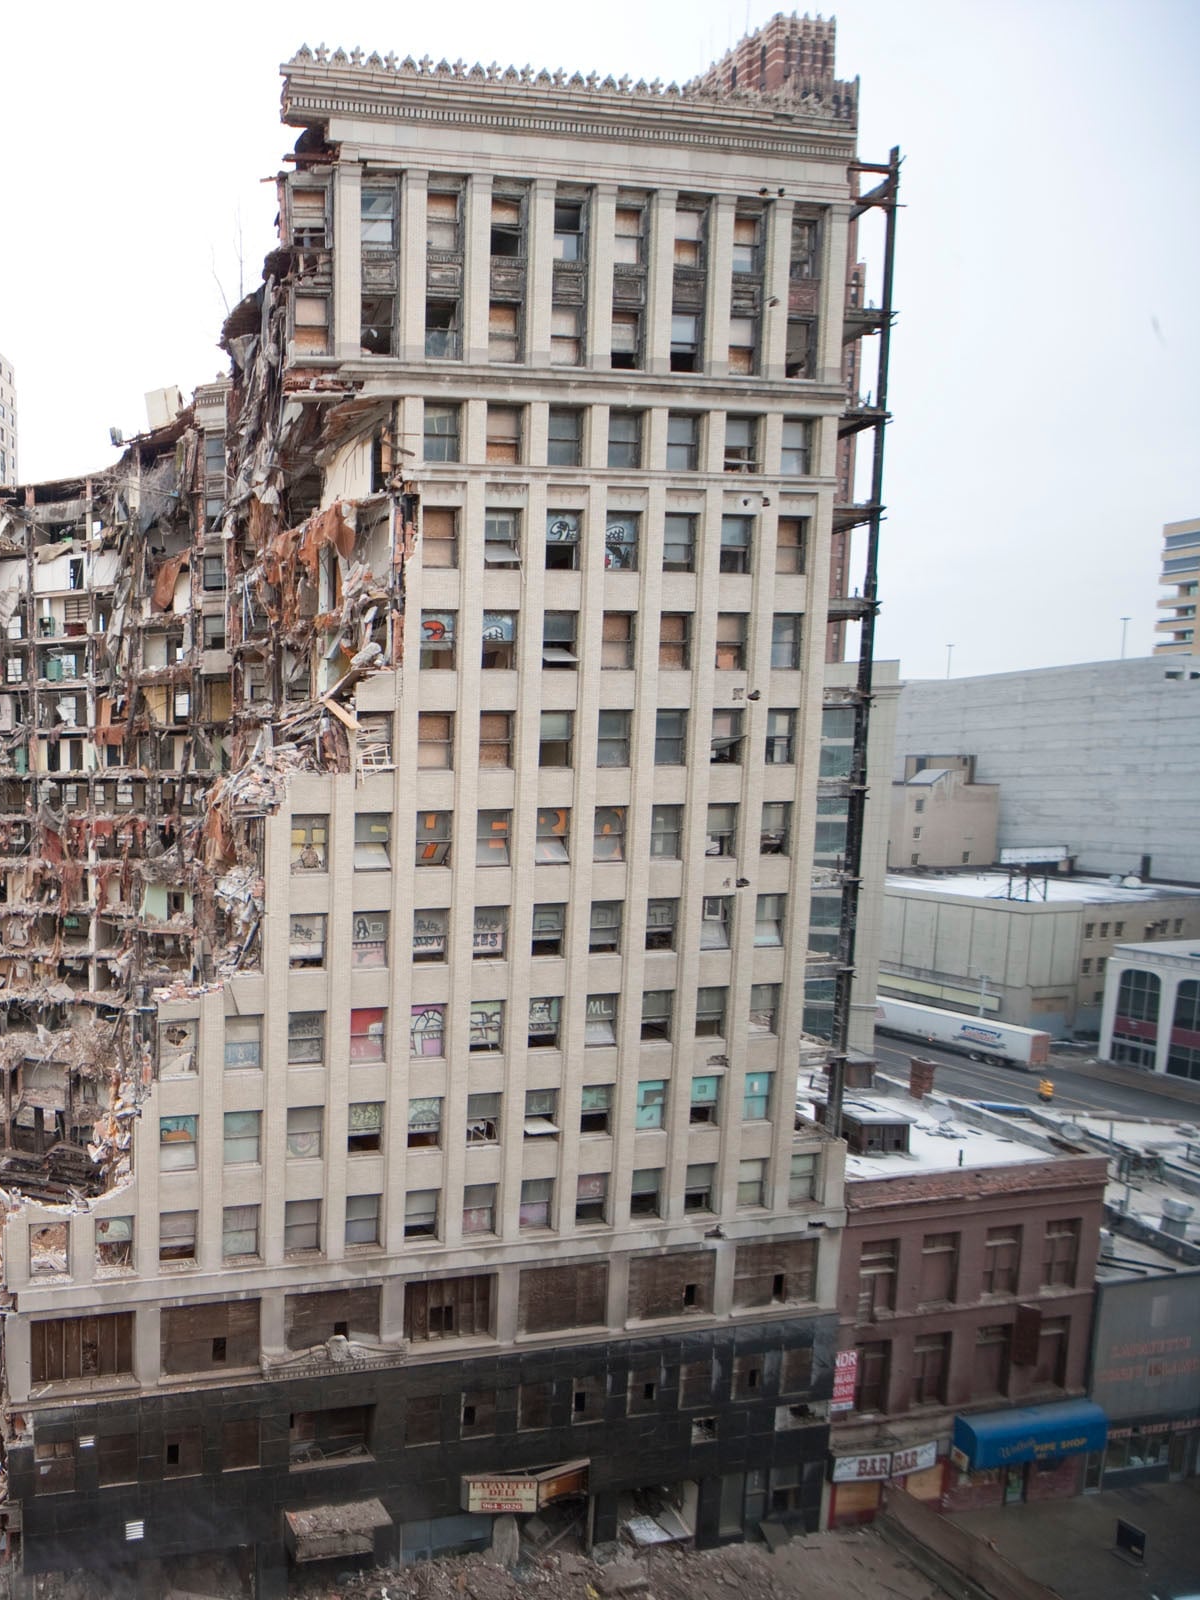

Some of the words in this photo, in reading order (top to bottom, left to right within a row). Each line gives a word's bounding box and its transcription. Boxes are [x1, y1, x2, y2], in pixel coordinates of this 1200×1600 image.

[588, 1001, 612, 1015] ML
[1060, 1436, 1088, 1450] SHOP
[856, 1456, 889, 1477] BAR
[894, 1450, 919, 1472] BAR
[489, 1489, 516, 1497] DELI
